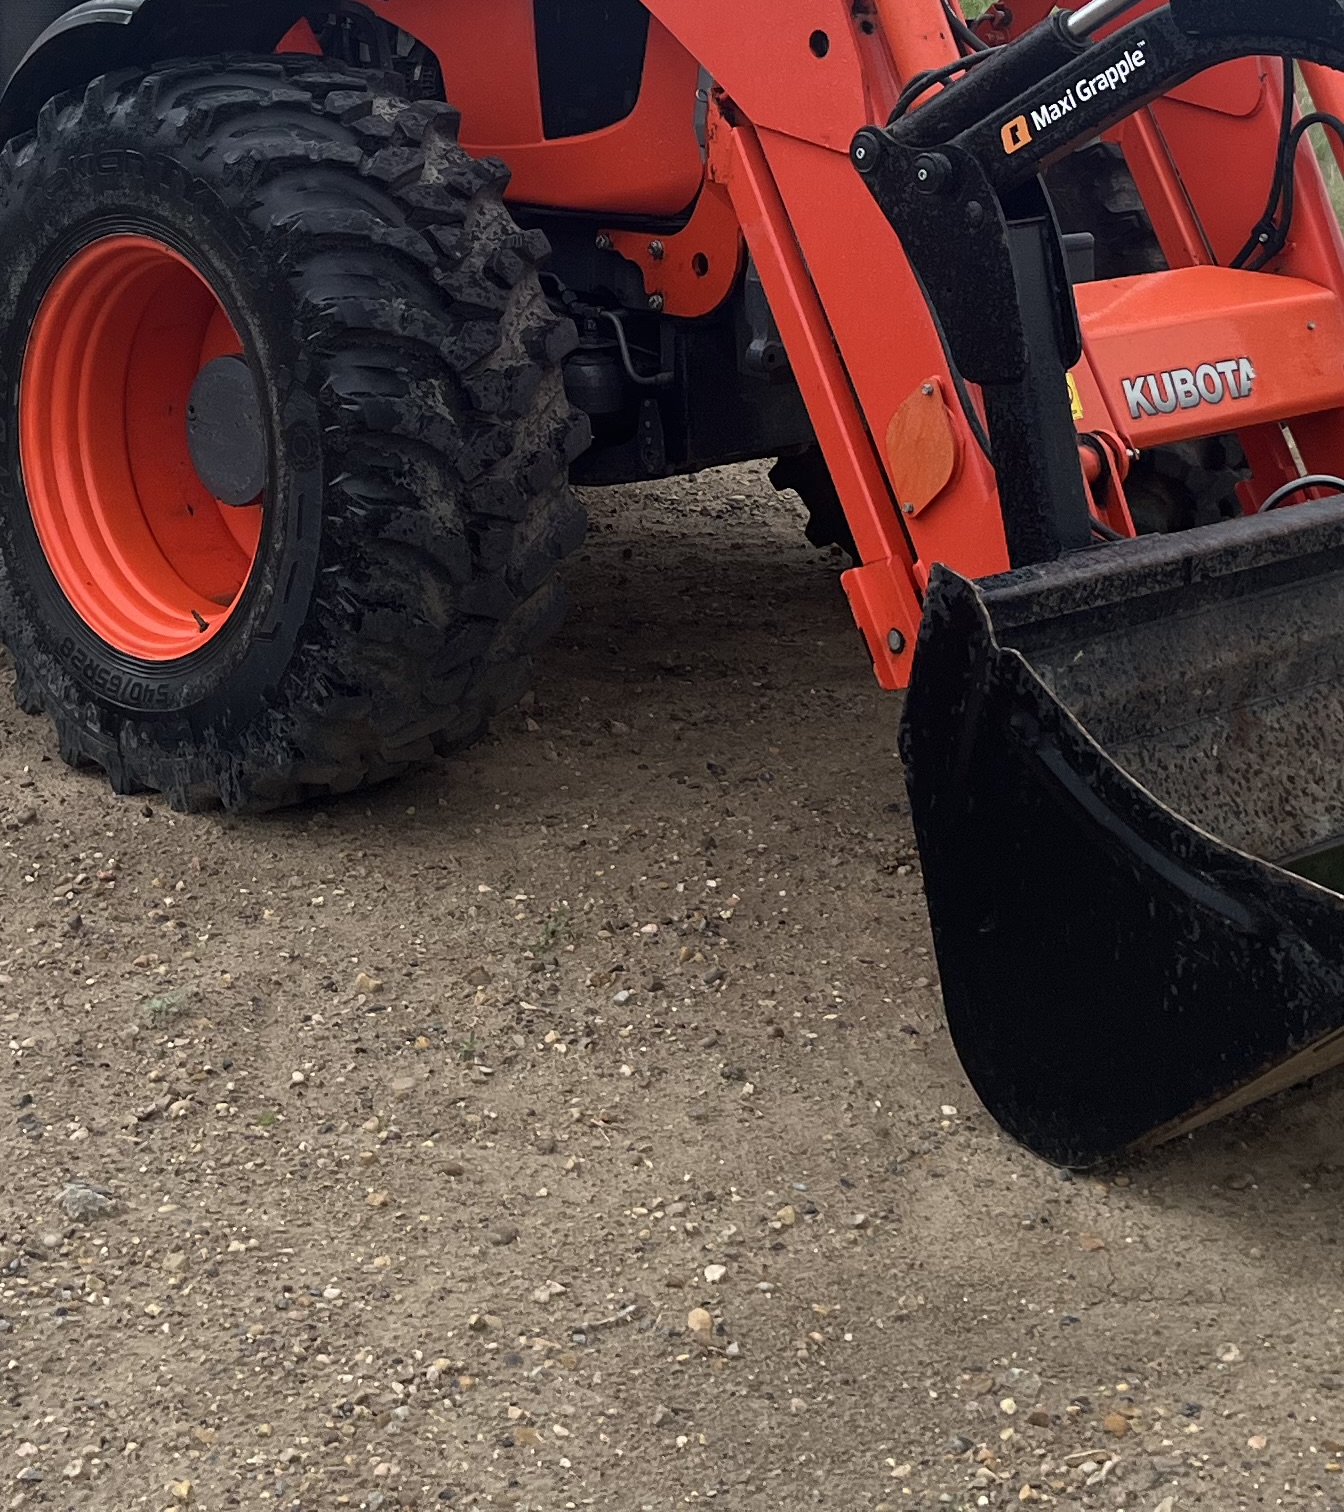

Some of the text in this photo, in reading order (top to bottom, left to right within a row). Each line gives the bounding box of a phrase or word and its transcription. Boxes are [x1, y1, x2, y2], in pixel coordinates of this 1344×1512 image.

[1030, 90, 1078, 132] Maxi
[1121, 355, 1256, 419] KUBOTA
[58, 636, 170, 704] 540/65R28
